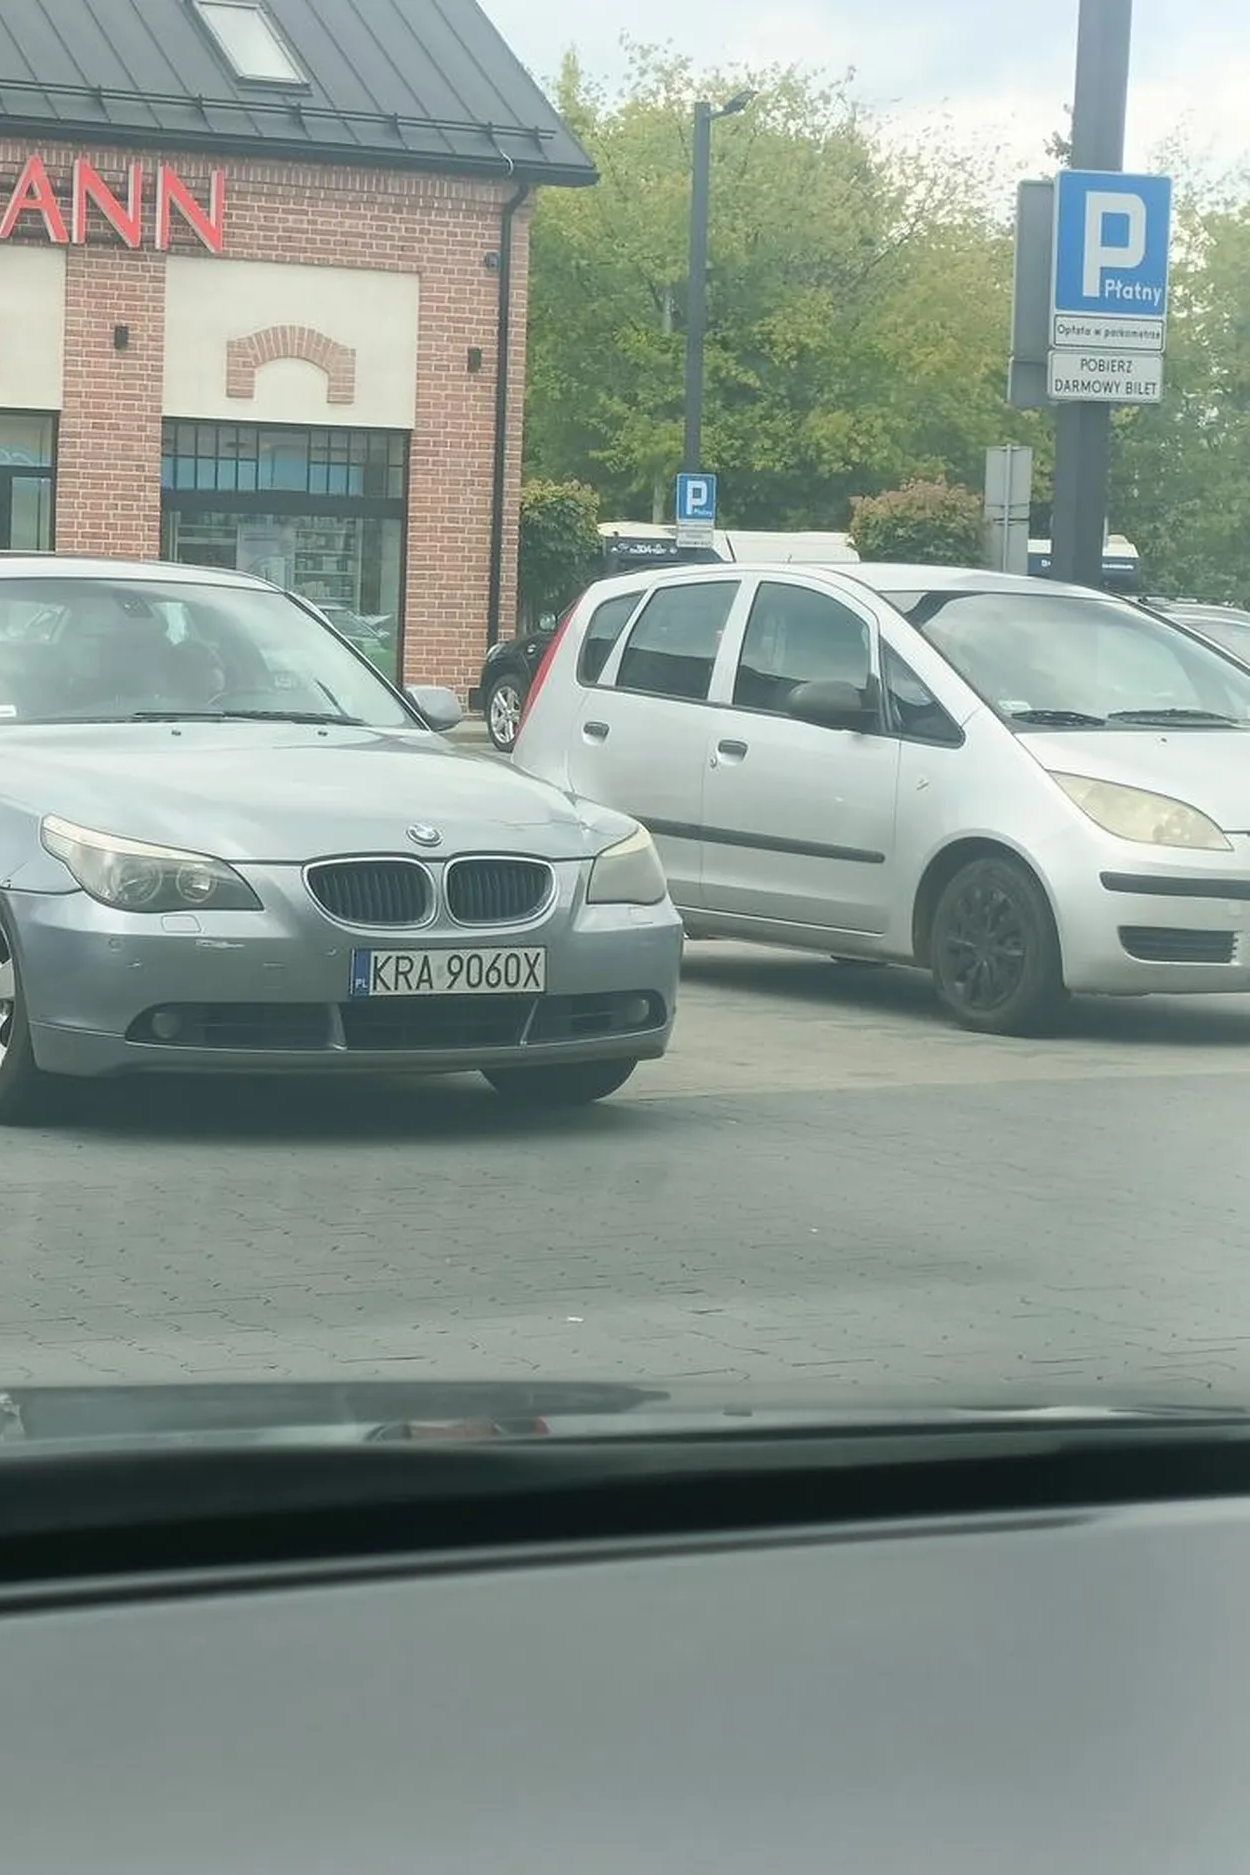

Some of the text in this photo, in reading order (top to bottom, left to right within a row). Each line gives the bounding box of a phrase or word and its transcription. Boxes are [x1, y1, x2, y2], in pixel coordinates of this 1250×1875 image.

[1082, 190, 1146, 297] P
[1104, 279, 1162, 306] Płatny
[1081, 358, 1132, 374] POBIERZ
[1055, 379, 1157, 395] DARMOWY BILET
[686, 480, 707, 515] P
[372, 952, 541, 992] KRA 9060X
